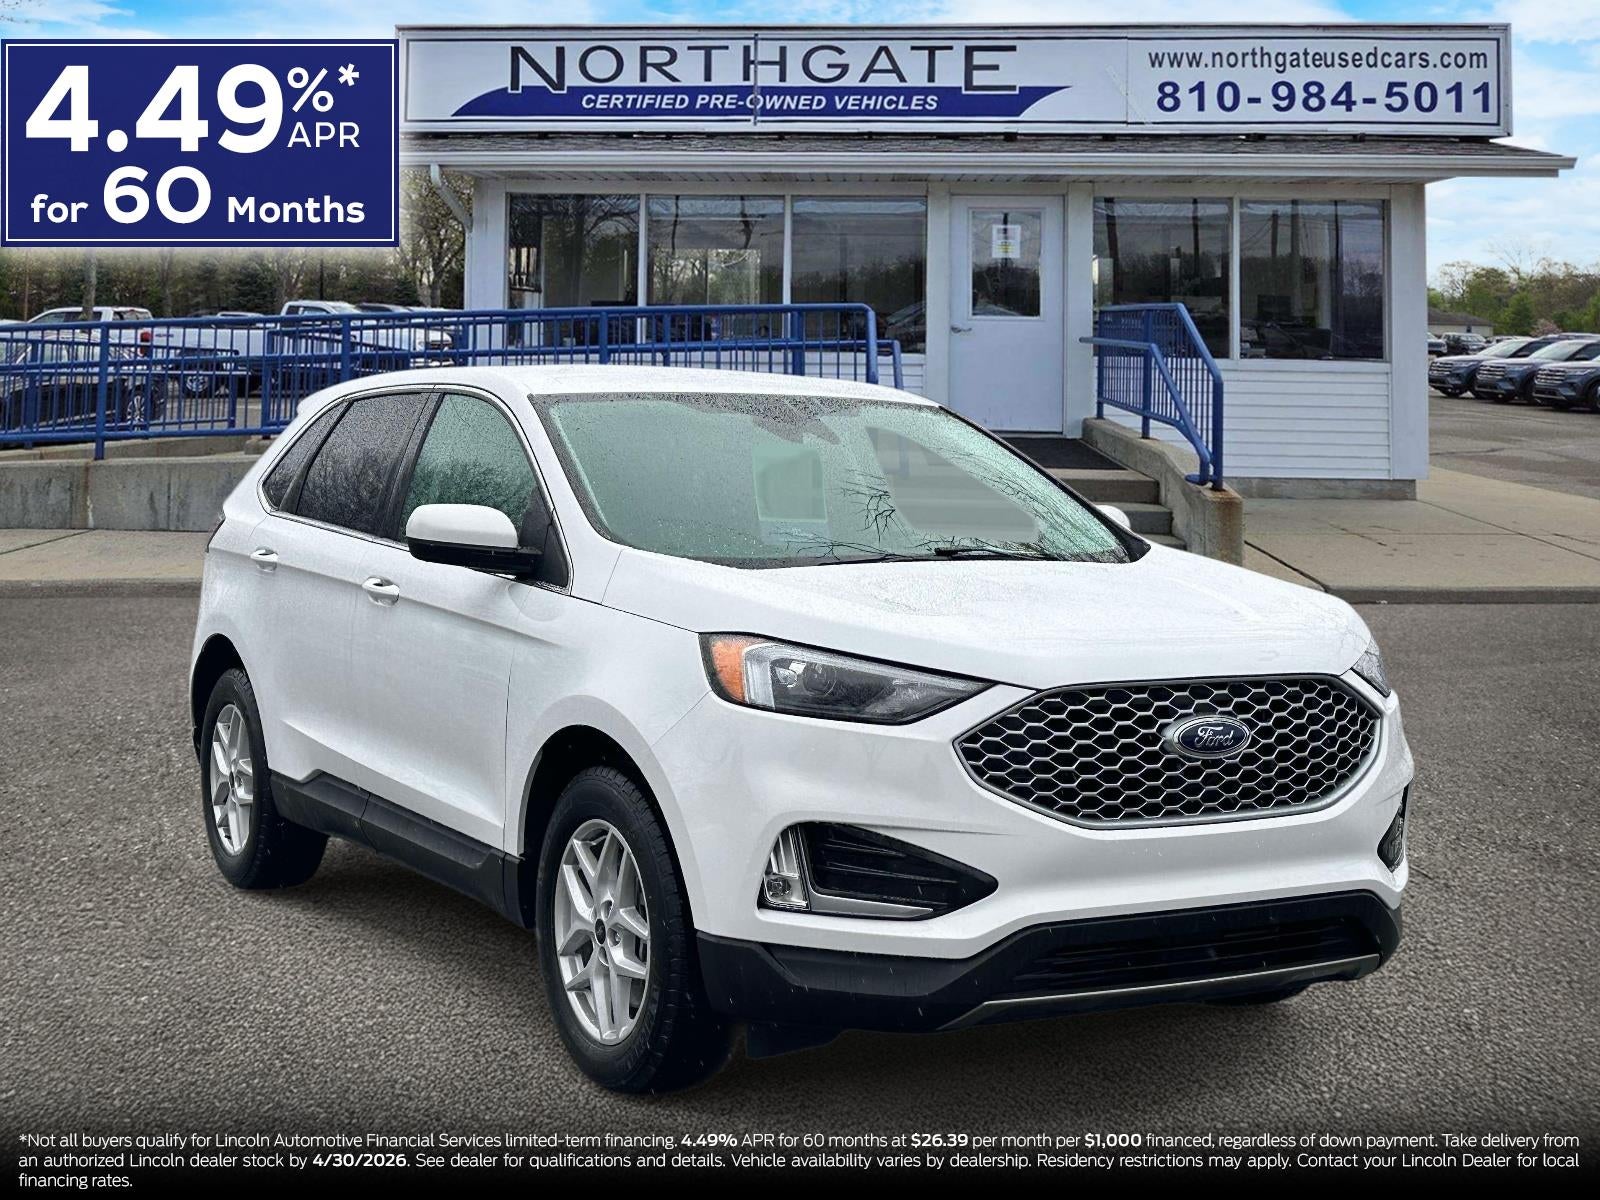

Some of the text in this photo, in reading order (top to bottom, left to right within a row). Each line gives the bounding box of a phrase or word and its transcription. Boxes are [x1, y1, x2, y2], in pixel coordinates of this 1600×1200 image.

[509, 45, 1018, 92] NORTHGATE
[1149, 47, 1488, 73] www.northgateusedcars.com
[581, 94, 939, 110] CERTIFIED PRE-OWNED VEHICLES
[1156, 80, 1491, 113] 810-984-5011
[1194, 726, 1234, 747] Ford
